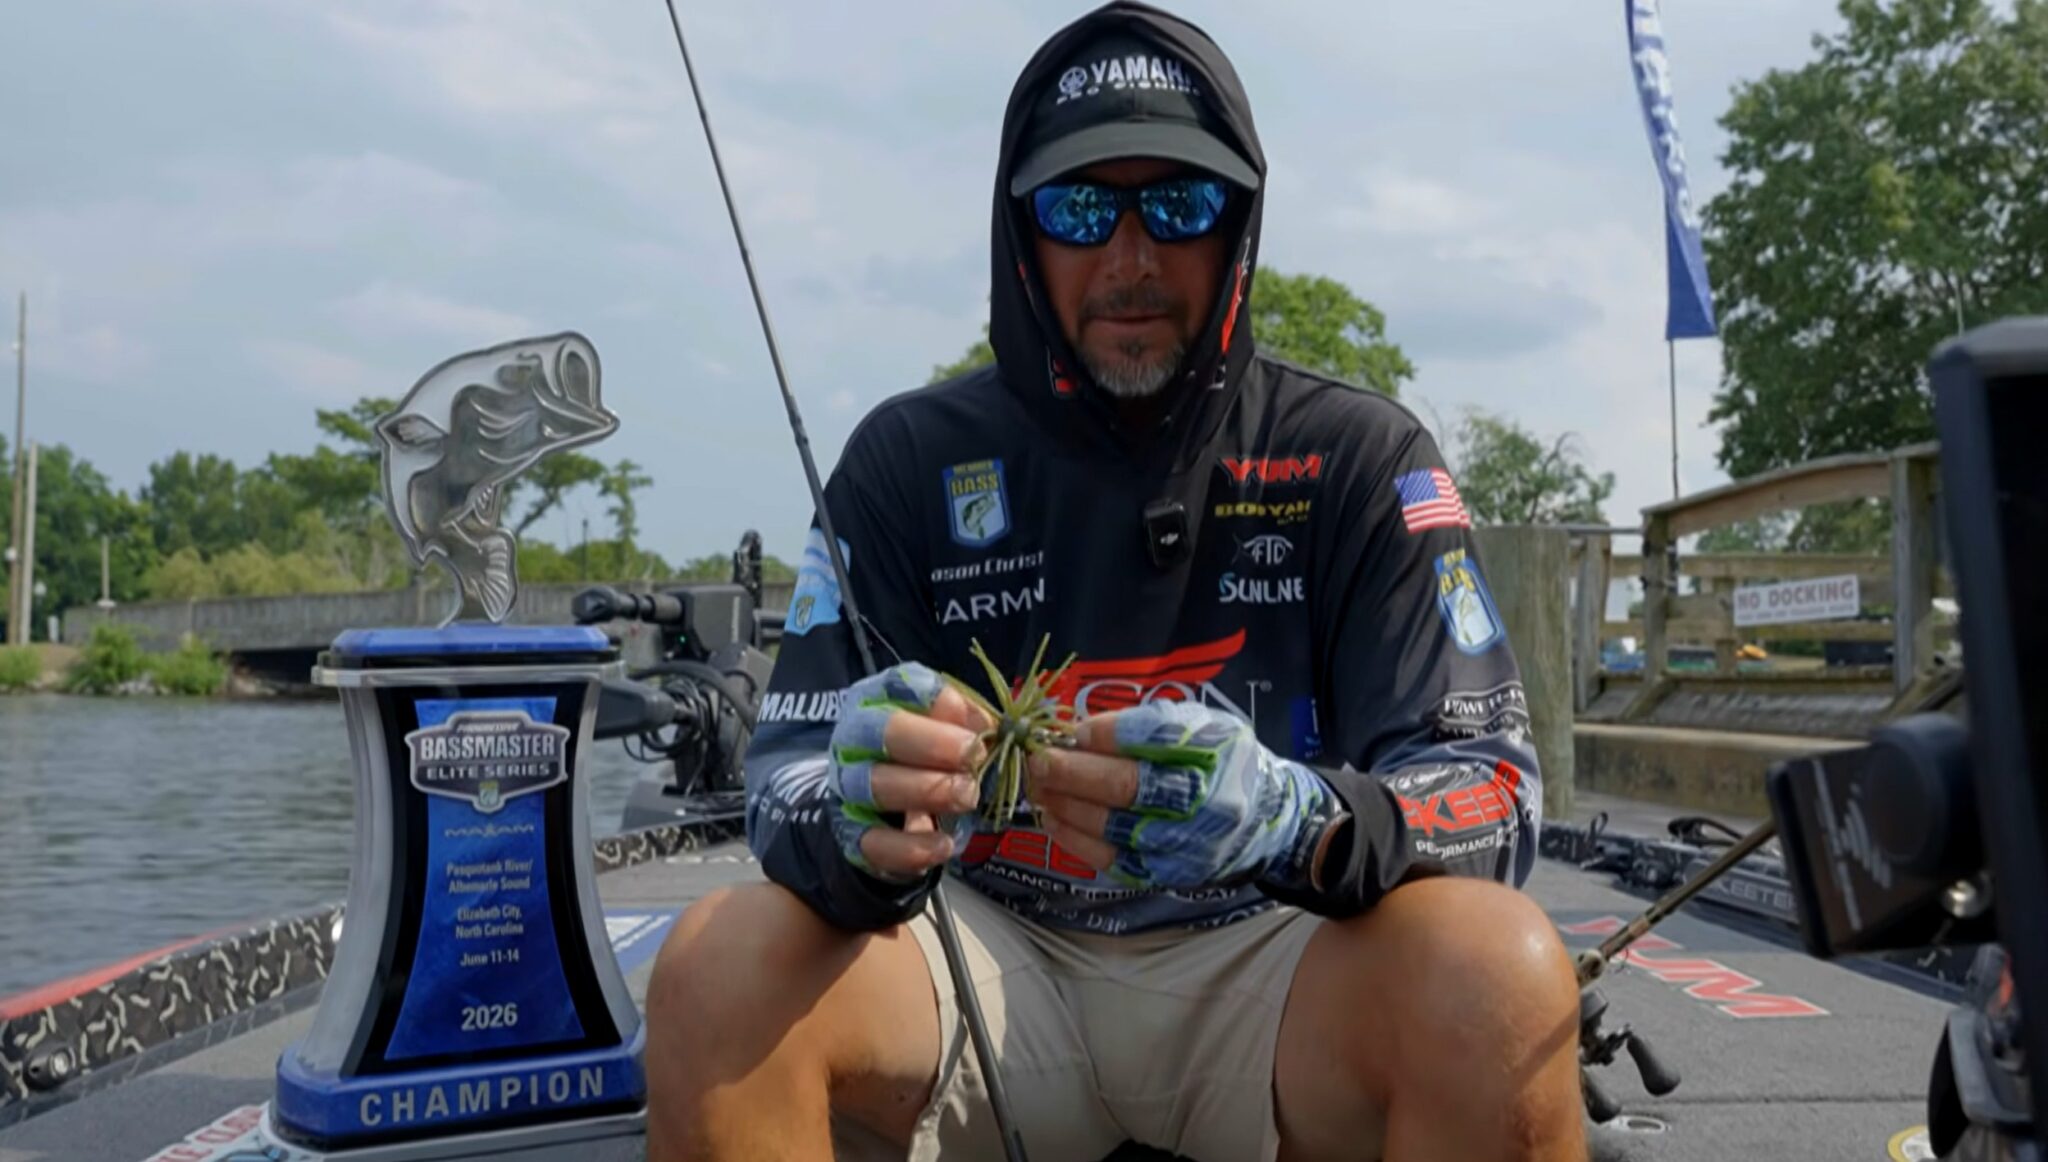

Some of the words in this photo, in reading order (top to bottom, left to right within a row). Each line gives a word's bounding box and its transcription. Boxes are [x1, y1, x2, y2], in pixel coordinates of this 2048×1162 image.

[1091, 54, 1191, 86] YAMAH
[1221, 454, 1323, 483] YUM
[952, 473, 998, 497] BASS
[931, 565, 981, 582] ason
[984, 550, 1044, 575] Christ
[1737, 592, 1761, 609] NO
[1768, 579, 1854, 608] DOCKING
[421, 733, 555, 760] BASSMASTER
[427, 766, 478, 780] ELITE
[484, 763, 550, 778] SERIES
[501, 876, 530, 890] Sound
[457, 907, 500, 922] Elizabeth
[456, 925, 482, 940] North
[484, 922, 524, 937] Carolina
[460, 952, 488, 967] June
[491, 948, 520, 963] 11-14
[461, 1003, 519, 1031] 2026
[360, 1066, 604, 1127] CHAMPION
